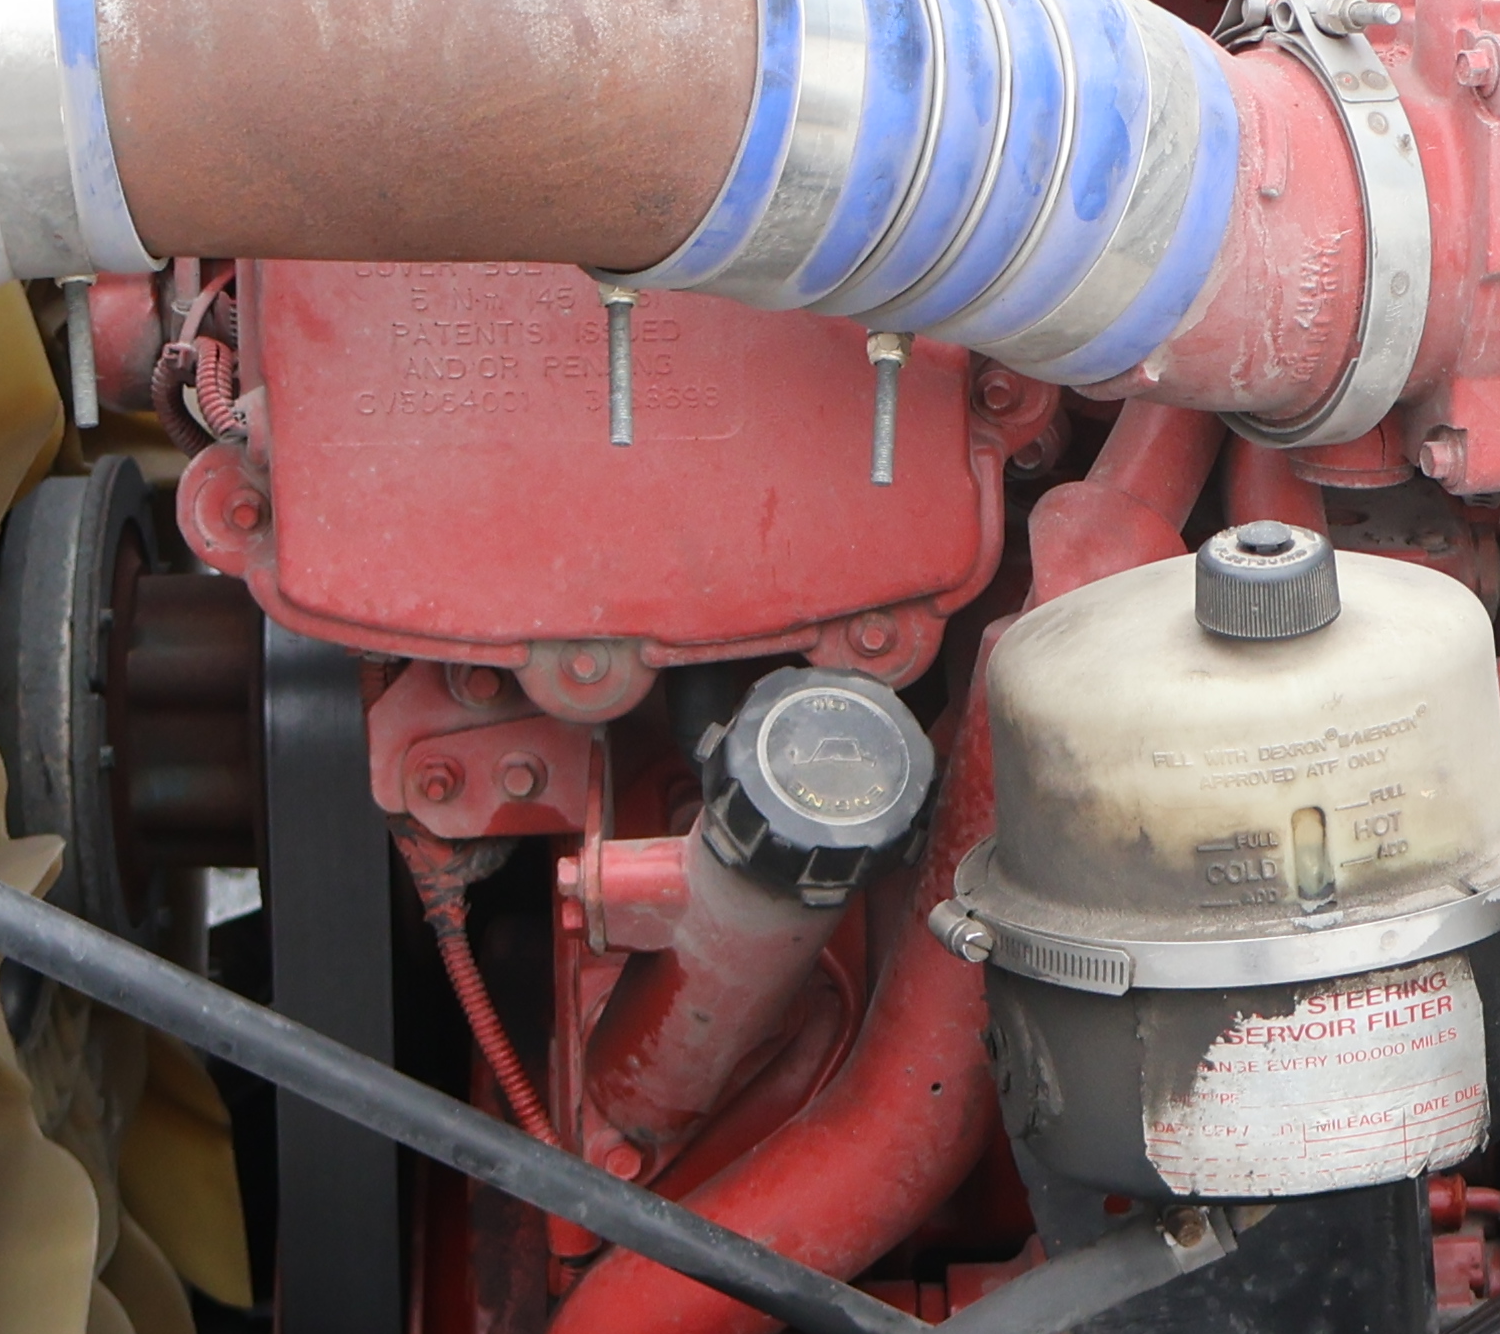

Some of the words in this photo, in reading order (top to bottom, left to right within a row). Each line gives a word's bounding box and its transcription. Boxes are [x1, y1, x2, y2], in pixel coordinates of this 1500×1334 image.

[1152, 751, 1194, 768] FILL
[1204, 748, 1248, 765] WITH
[1200, 767, 1297, 790] APPROVED
[1306, 758, 1340, 778] ATF
[1348, 747, 1389, 769] ONLY
[1368, 783, 1405, 804] FULL
[1354, 811, 1402, 840] HOT
[1235, 832, 1278, 850] FULL
[1376, 840, 1408, 860] ADD
[1205, 858, 1278, 885] COLD
[1306, 970, 1448, 1015] STEERING
[1367, 995, 1454, 1033] FILTER
[1267, 1054, 1328, 1073] EVERY
[1336, 1041, 1406, 1066] 100,000
[1411, 1027, 1458, 1052] MILES
[1315, 1110, 1393, 1133] MILEAGE
[1413, 1095, 1451, 1116] DATE
[1454, 1083, 1482, 1104] DUE
